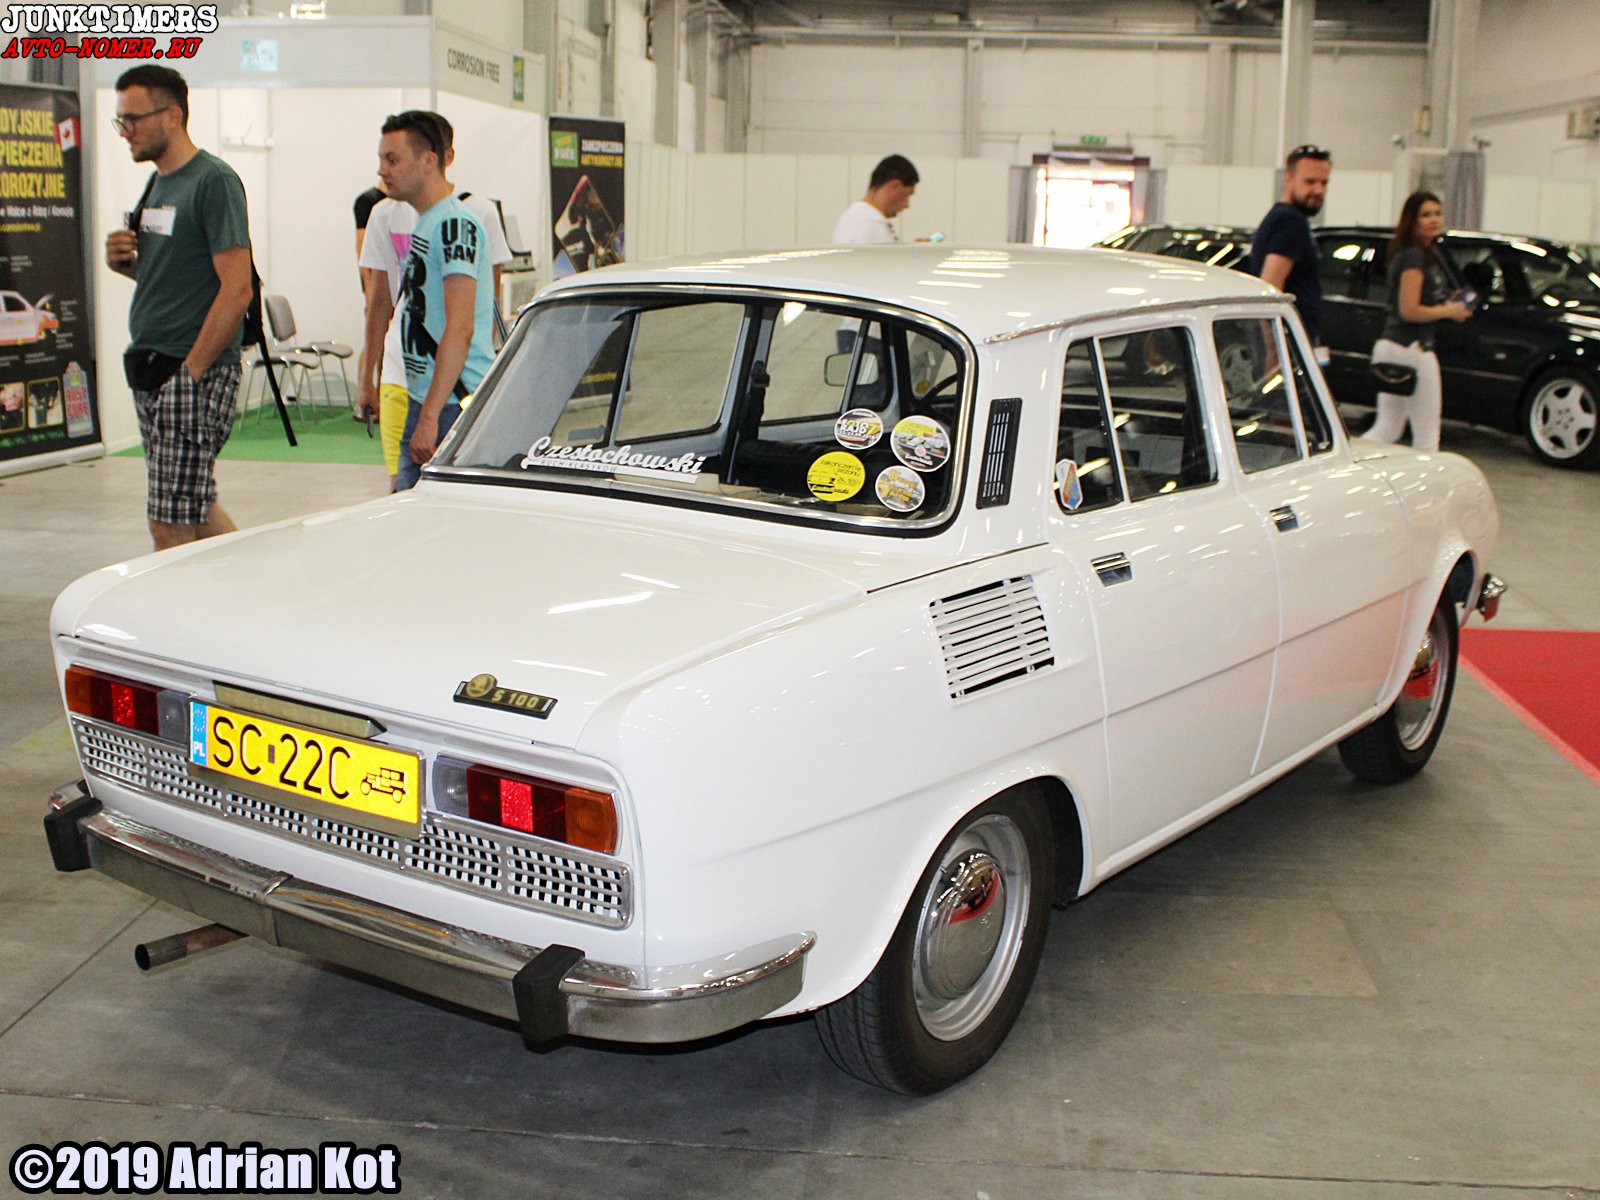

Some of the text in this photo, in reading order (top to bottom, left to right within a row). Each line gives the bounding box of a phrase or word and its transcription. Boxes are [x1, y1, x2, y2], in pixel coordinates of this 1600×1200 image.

[447, 48, 500, 83] CORROSION FREE
[0, 172, 66, 199] OROZYJNE
[442, 217, 477, 248] UR
[508, 693, 540, 709] 100
[193, 741, 205, 757] PL
[213, 715, 351, 800] SC 22C
